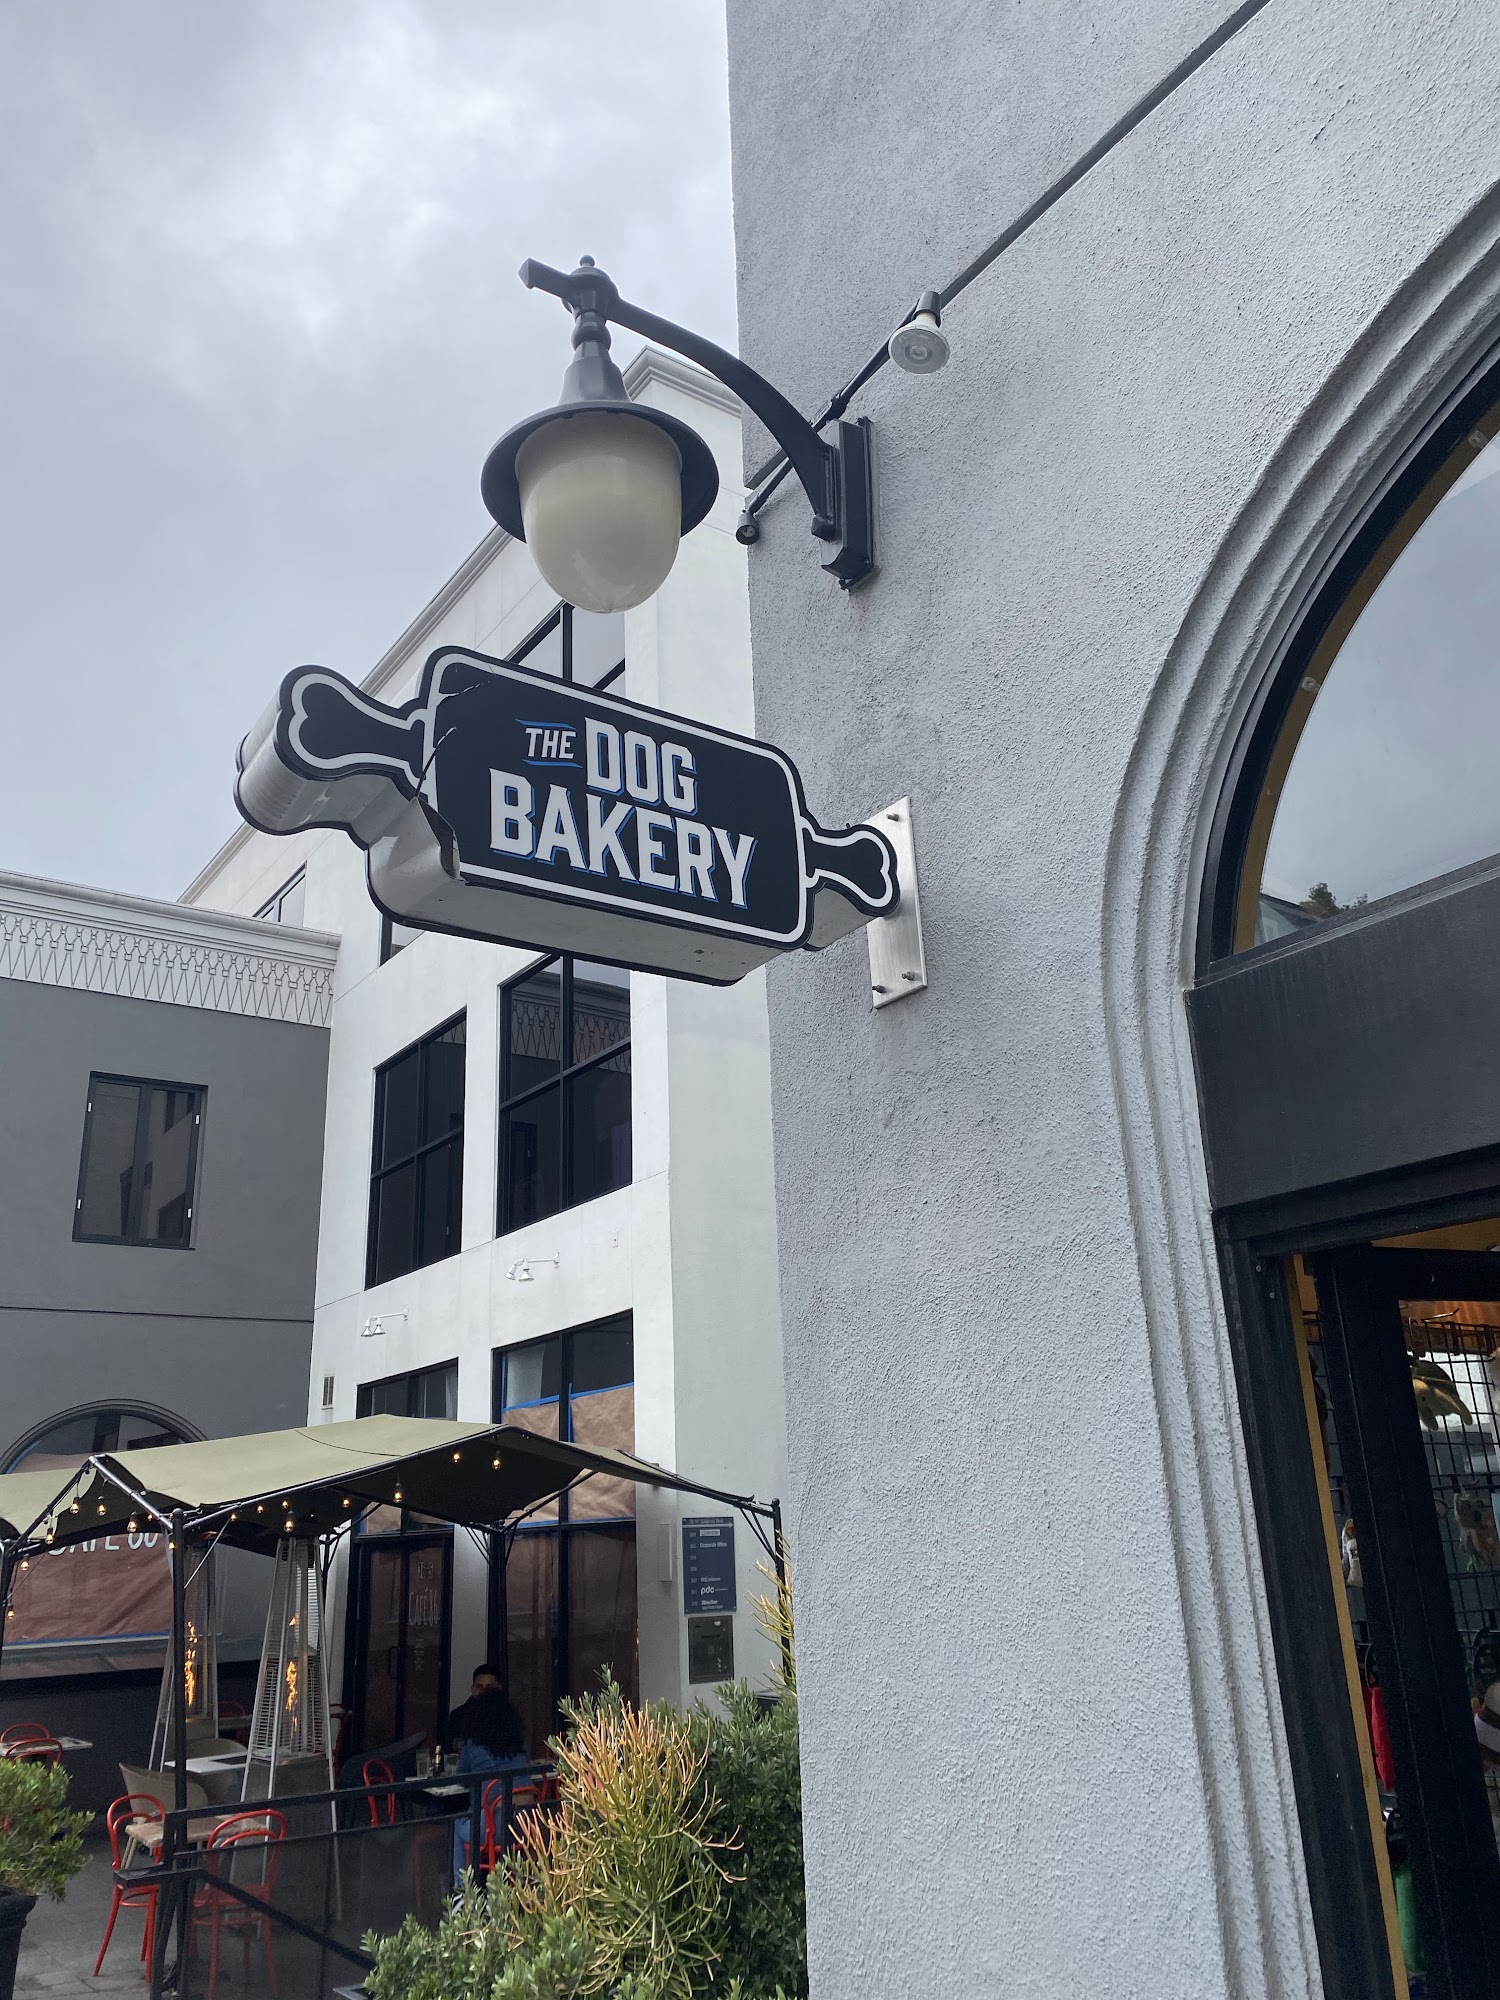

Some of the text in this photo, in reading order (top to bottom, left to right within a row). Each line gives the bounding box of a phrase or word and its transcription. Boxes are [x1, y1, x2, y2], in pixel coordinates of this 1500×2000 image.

[525, 717, 697, 815] THE DOG
[489, 767, 757, 908] BAKERY
[701, 1585, 715, 1595] pdc
